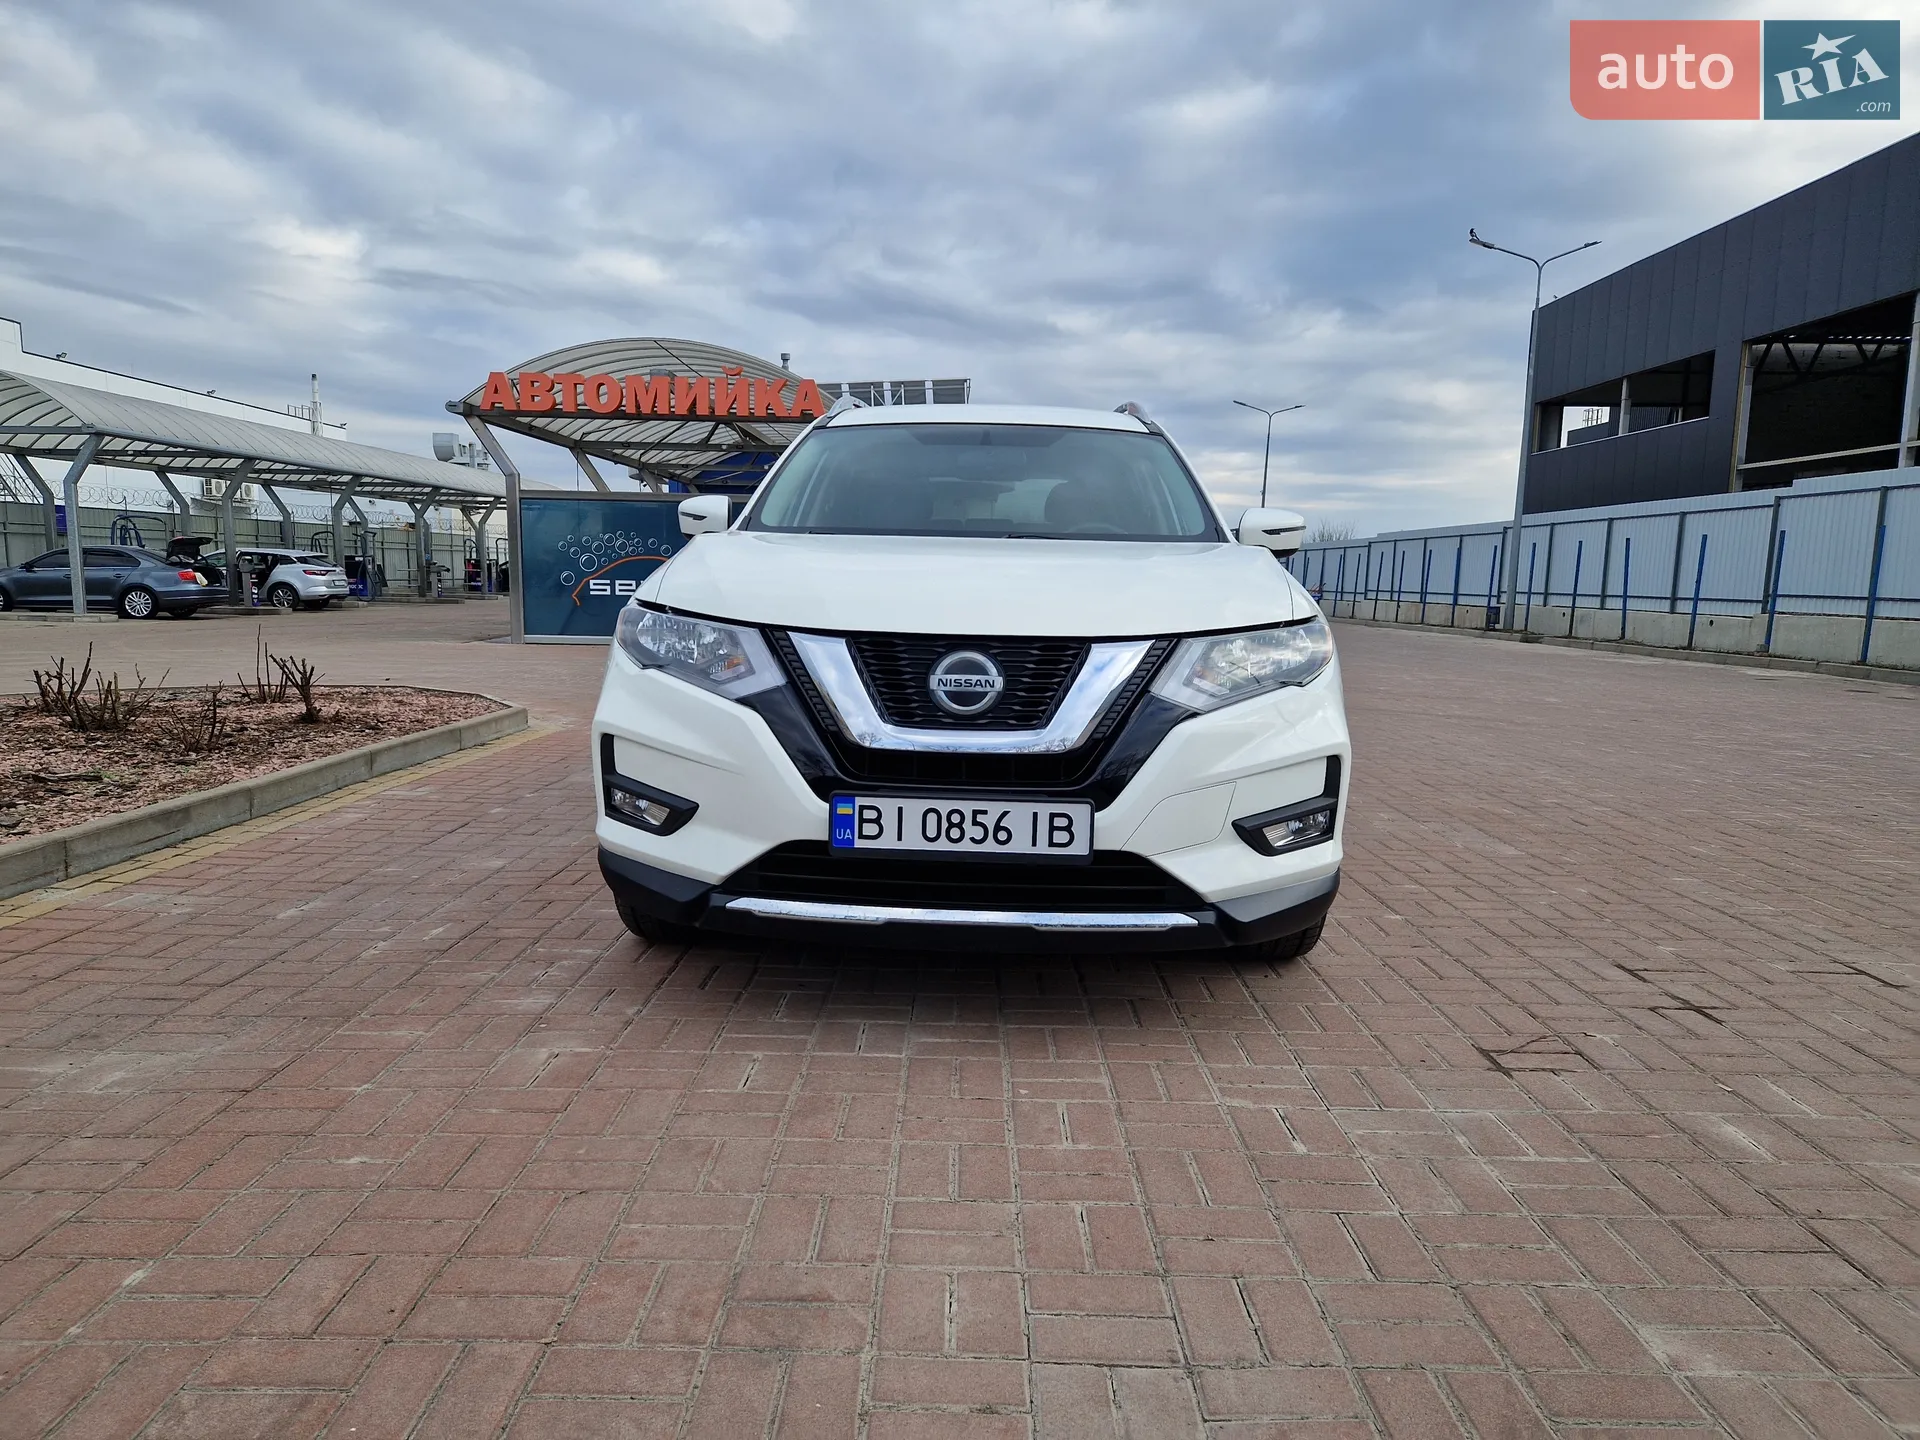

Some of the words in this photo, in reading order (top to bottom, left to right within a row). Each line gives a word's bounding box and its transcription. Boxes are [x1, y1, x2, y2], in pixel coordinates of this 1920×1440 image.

[479, 365, 826, 417] АВТОМИЙКА
[937, 677, 995, 689] NISSAN
[836, 828, 853, 840] UA
[857, 804, 904, 841] BI
[921, 807, 1013, 845] 0856
[1030, 811, 1076, 848] IB
